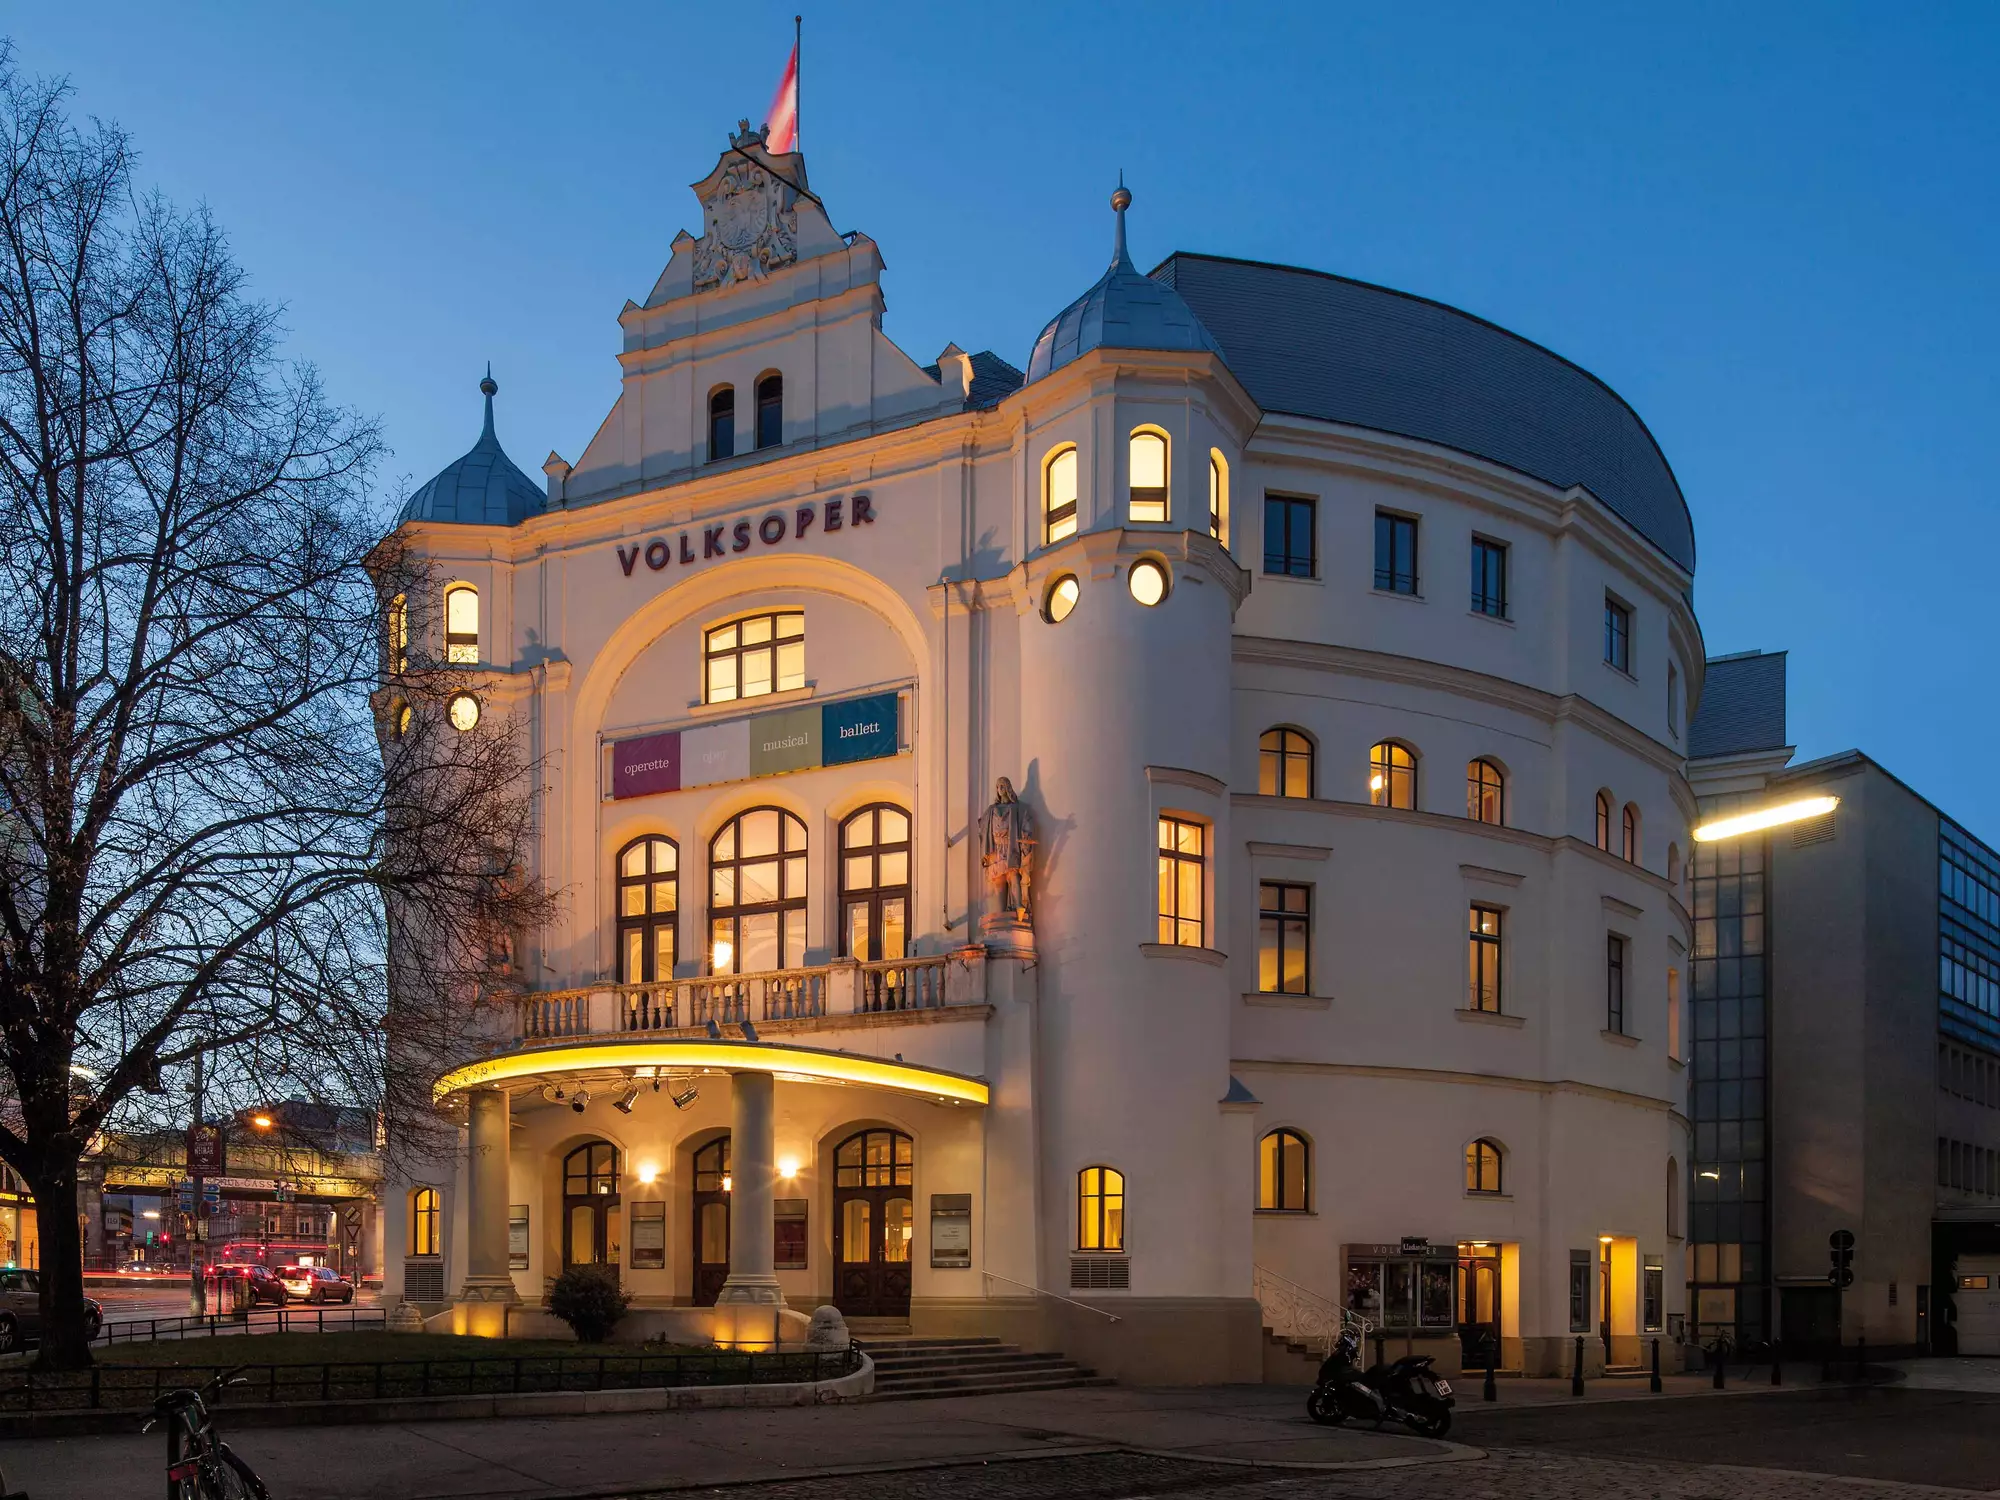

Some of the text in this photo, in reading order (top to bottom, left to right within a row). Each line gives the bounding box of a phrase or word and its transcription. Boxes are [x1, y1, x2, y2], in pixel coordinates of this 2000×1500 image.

[617, 495, 875, 576] VOLKSOPER
[839, 721, 880, 739] ballett
[762, 733, 809, 751] musical
[624, 757, 669, 775] operette
[1373, 1246, 1437, 1256] VOLKER
